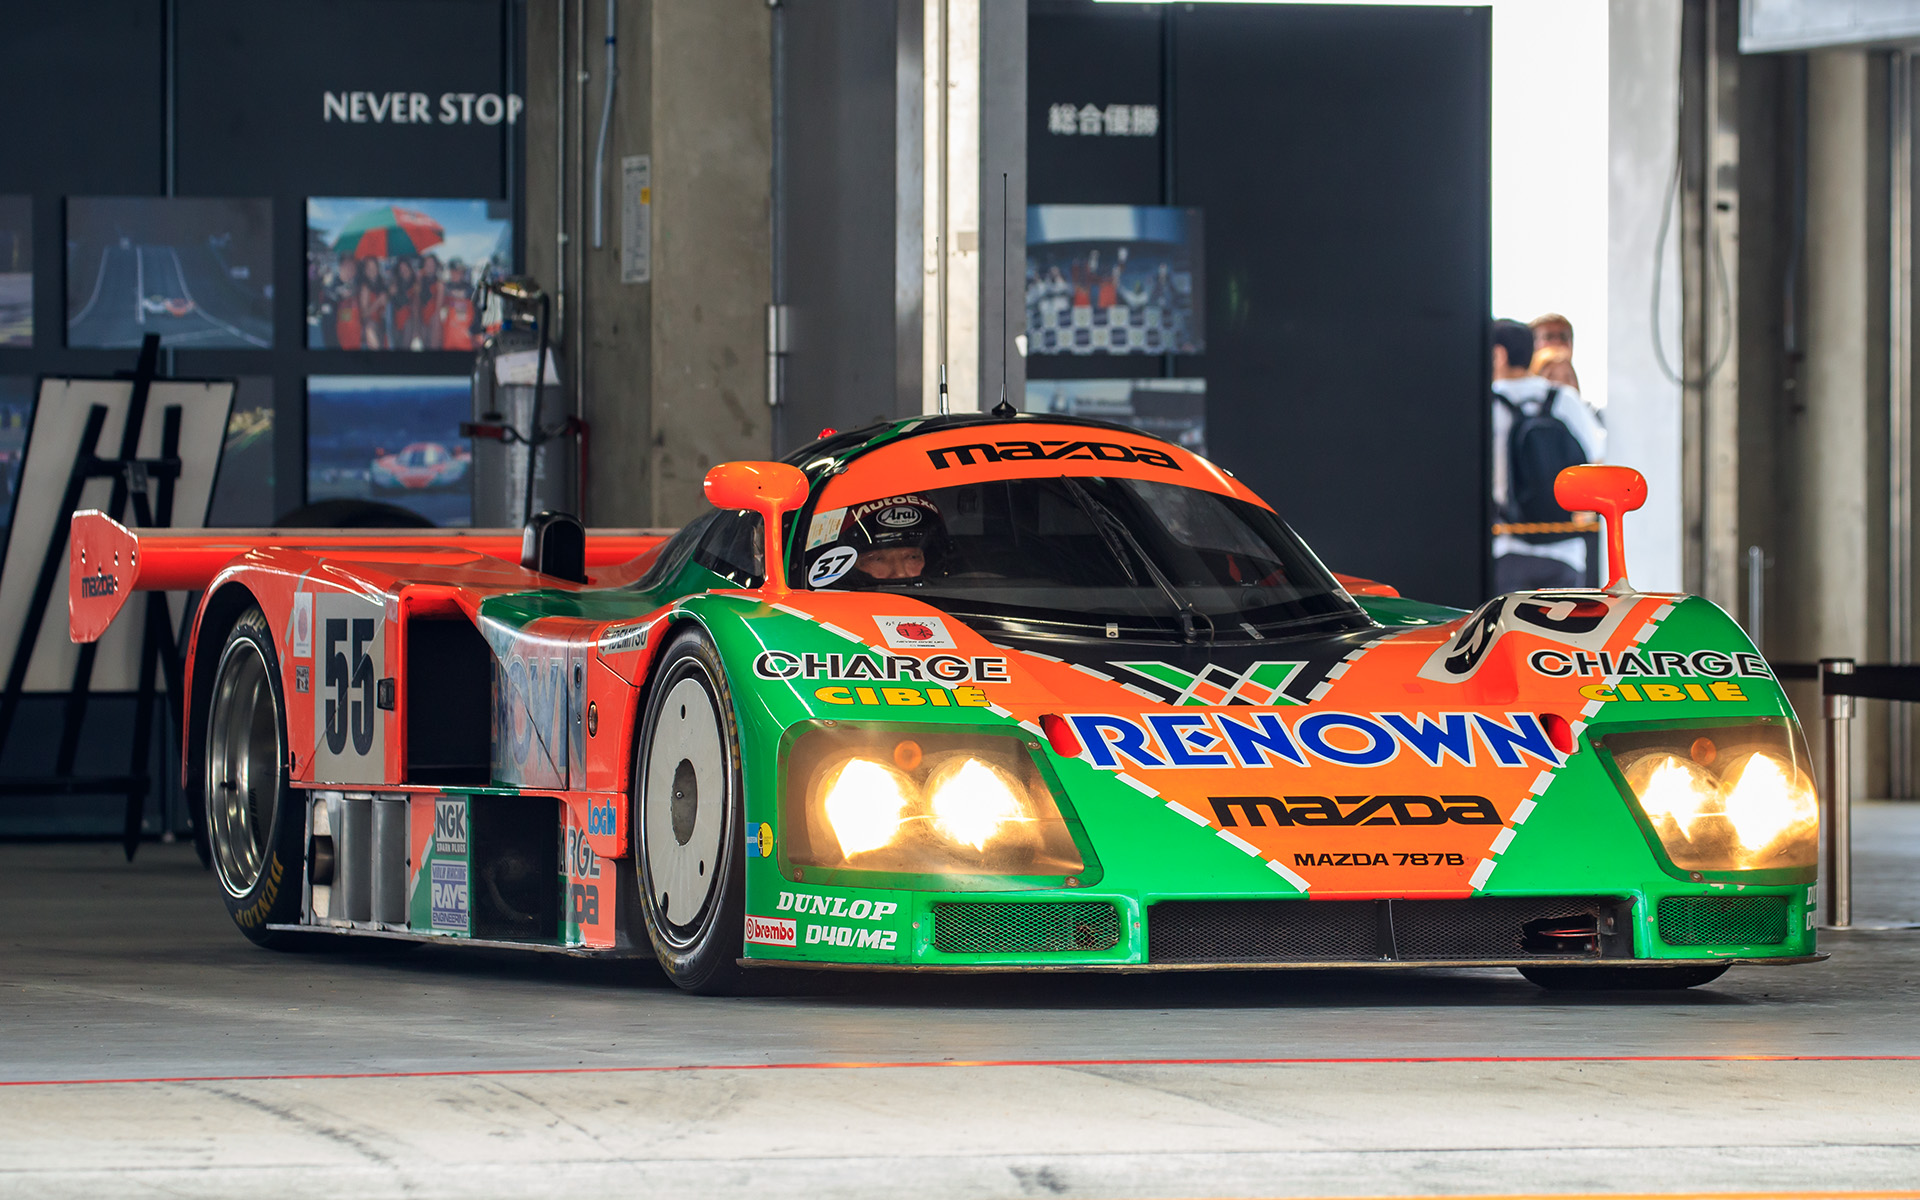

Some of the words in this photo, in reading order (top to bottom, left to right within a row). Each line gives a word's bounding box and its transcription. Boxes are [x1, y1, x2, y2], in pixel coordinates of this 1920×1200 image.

[323, 91, 433, 124] NEVER
[438, 92, 523, 126] STOP
[1048, 102, 1159, 136] 総合優勝
[926, 441, 1184, 470] mazda
[881, 508, 917, 521] Arai
[813, 553, 854, 581] 37
[82, 574, 114, 598] mazda
[753, 650, 1011, 684] CHARGE
[1527, 649, 1774, 681] CHARGE
[325, 618, 375, 756] 55
[1063, 712, 1567, 770] RENOWN
[436, 804, 466, 840] NGK
[1207, 795, 1504, 827] mazda
[436, 842, 451, 853] SPARK
[451, 842, 466, 853] PLUGS
[1294, 853, 1389, 866] MAZDA
[1393, 853, 1464, 866] 787B
[432, 883, 467, 910] RAYS
[776, 891, 897, 921] DUNLOP
[433, 911, 467, 924] ENGINEERING
[755, 920, 794, 941] brembo
[805, 924, 898, 950] D40/M2
